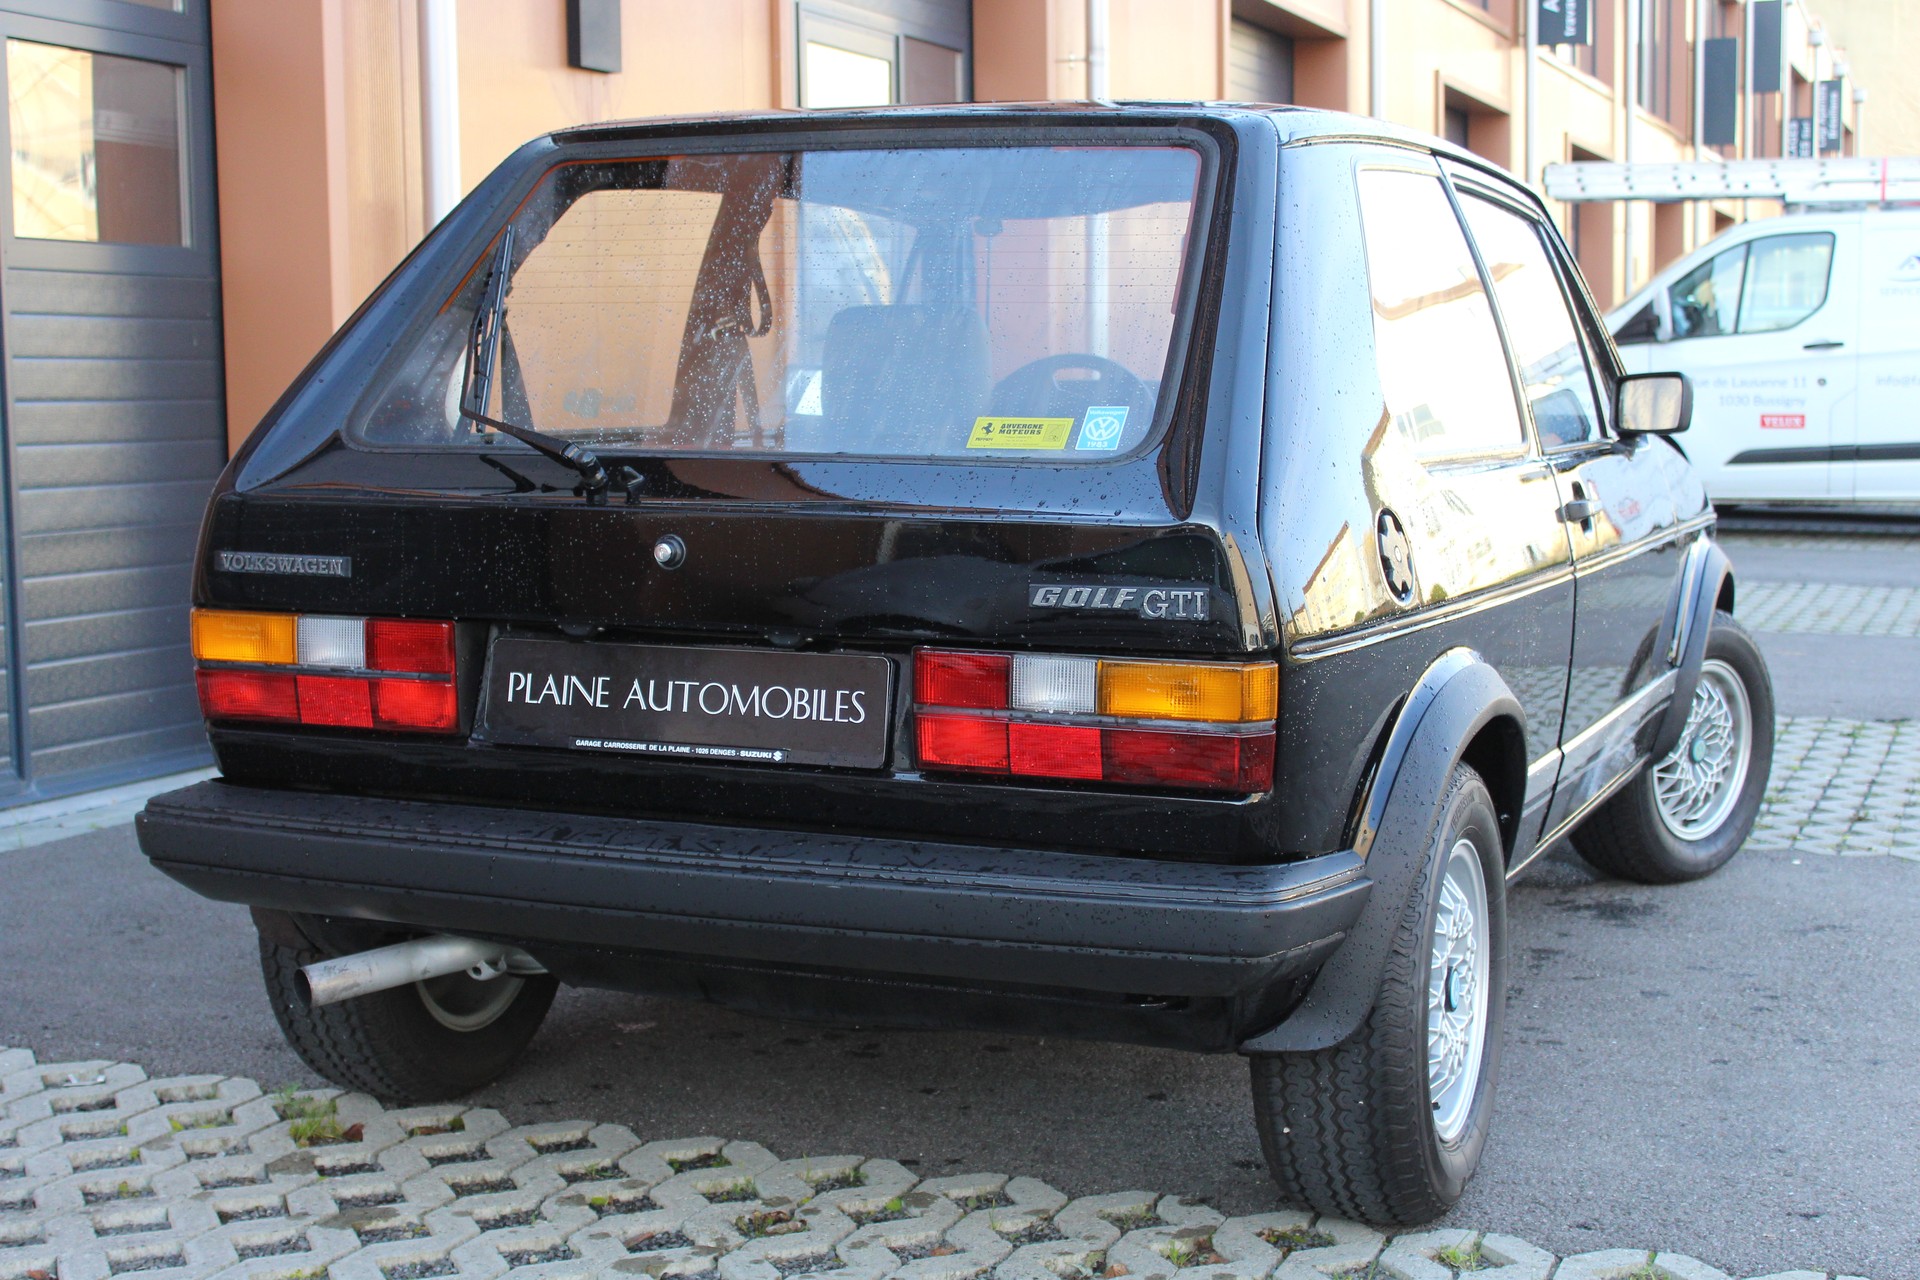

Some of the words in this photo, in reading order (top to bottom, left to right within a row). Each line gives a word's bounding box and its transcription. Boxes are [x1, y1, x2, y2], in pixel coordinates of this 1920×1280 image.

[1713, 376, 1728, 388] de
[1731, 376, 1788, 389] Lausanne
[220, 553, 343, 575] VOLKSWAGEN
[1032, 587, 1138, 609] GOLF
[1143, 589, 1206, 620] GTI
[507, 671, 611, 709] PLAINE
[623, 677, 866, 725] AUTOMOBILES
[575, 739, 602, 748] GARAGE
[603, 741, 647, 751] CARROSSERIE
[668, 746, 691, 754] PLAINE
[709, 748, 736, 756] DENGES
[740, 750, 772, 759] SUZUKI
